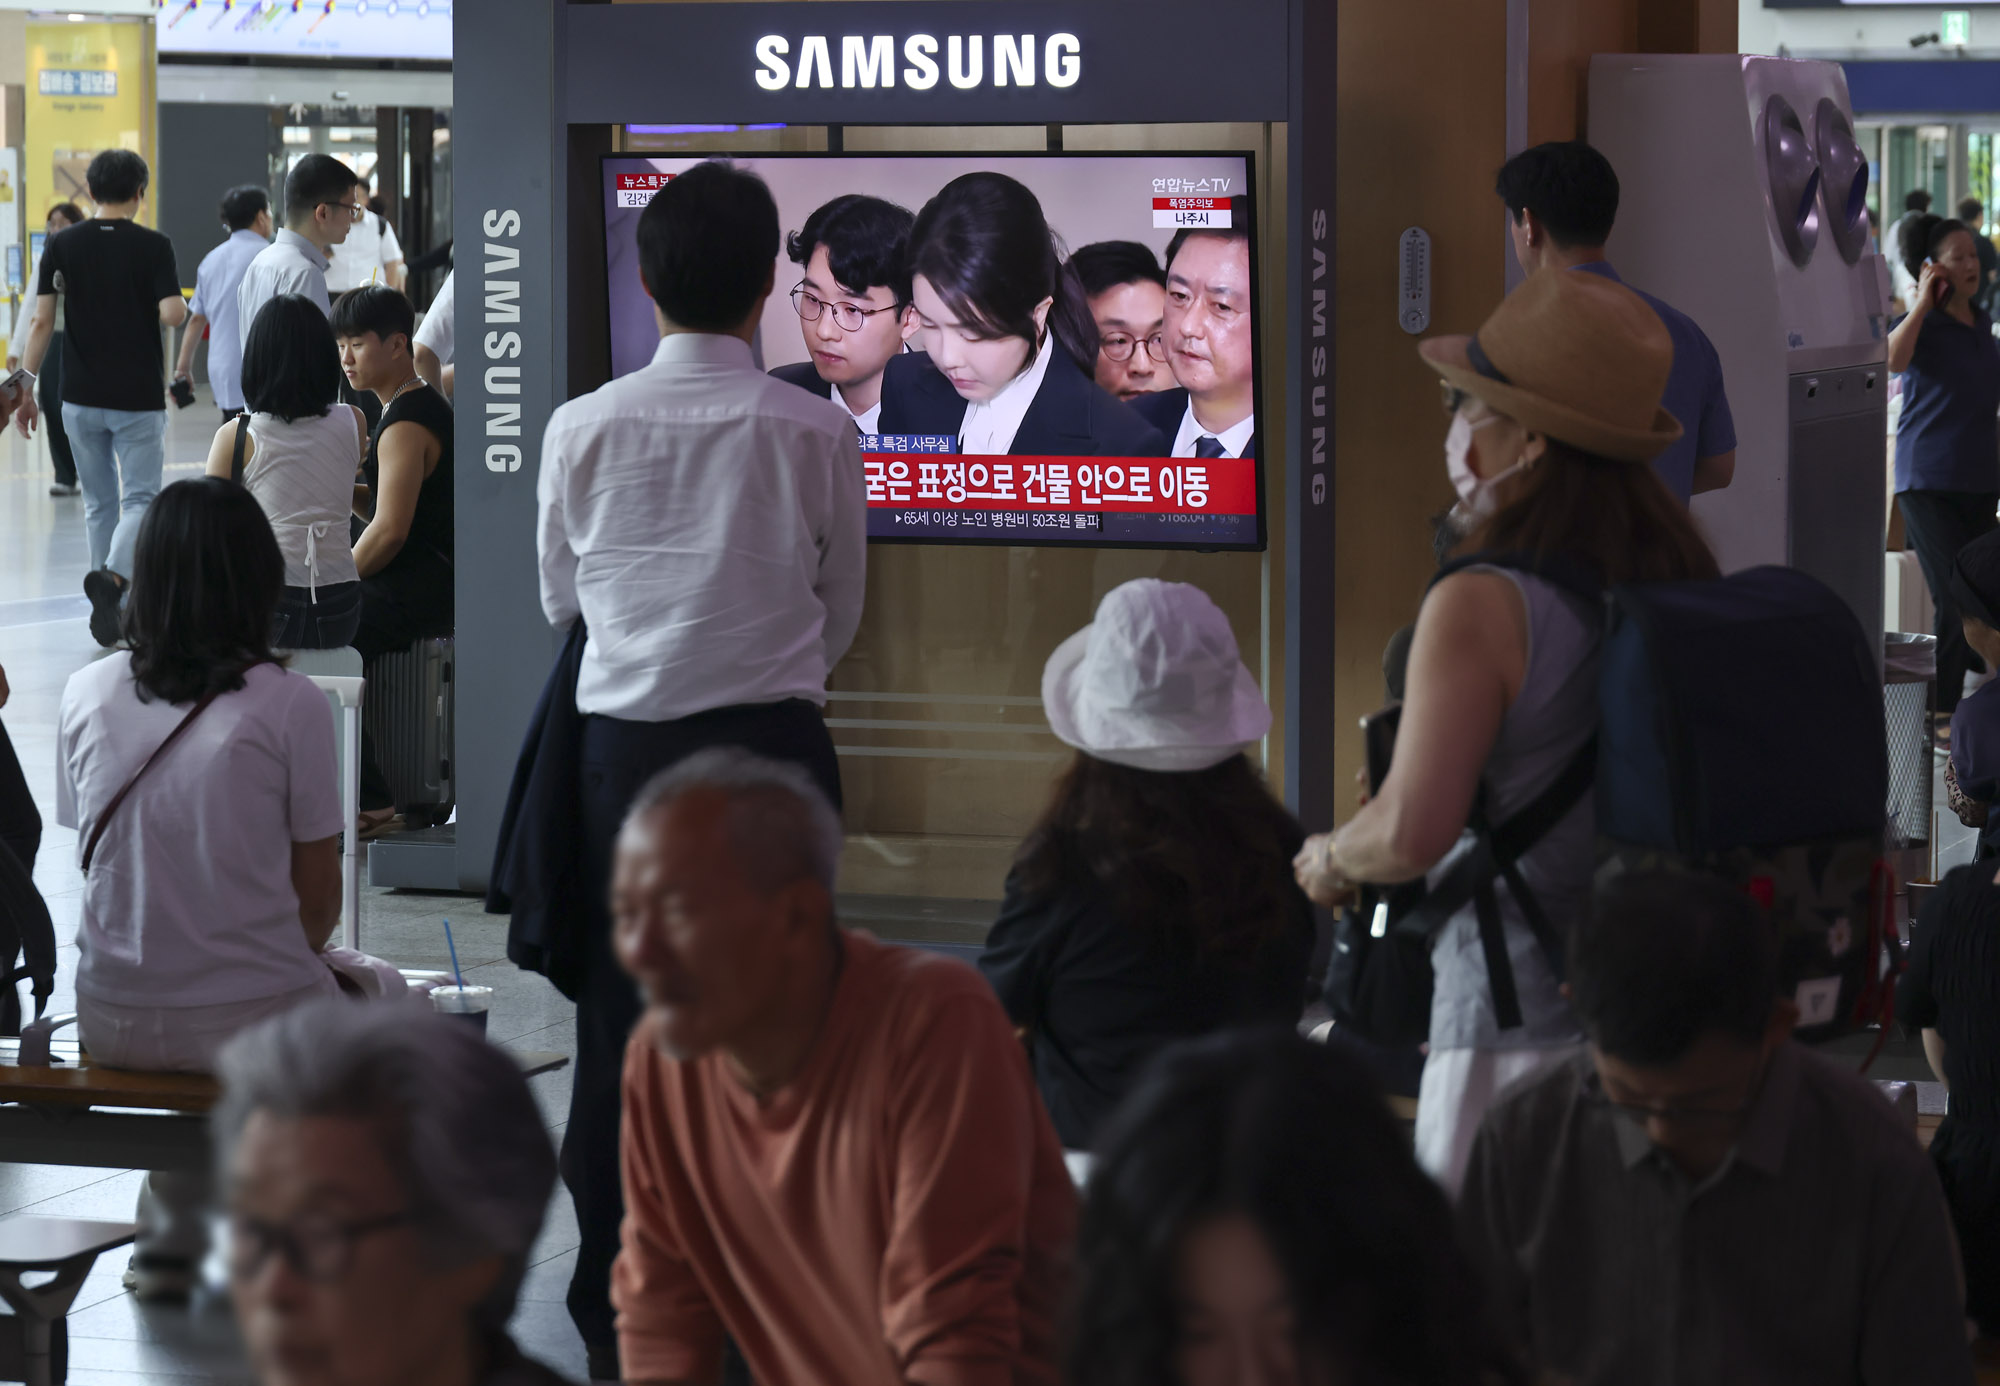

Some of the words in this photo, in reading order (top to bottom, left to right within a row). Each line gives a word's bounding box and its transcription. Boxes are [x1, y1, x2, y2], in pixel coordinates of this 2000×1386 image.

[755, 33, 1081, 90] SAMSUNG
[624, 175, 669, 188] 뉴스특보
[1169, 198, 1214, 209] 폭염주의보
[1175, 212, 1209, 225] 나주시
[483, 209, 522, 472] SAMSUNG
[1312, 209, 1326, 505] SAMSUNG
[882, 436, 908, 452] 특검
[911, 436, 950, 453] 사무실
[917, 462, 1017, 503] 표정으로
[1022, 464, 1072, 504] 건물
[1077, 465, 1154, 504] 안으로
[1159, 466, 1210, 508] 이동
[904, 511, 929, 525] 65세
[933, 512, 958, 526] 이상
[962, 512, 987, 527] 노인
[991, 512, 1029, 528] 병원비
[1032, 513, 1070, 529] 50조원
[1074, 513, 1100, 529] 돌파
